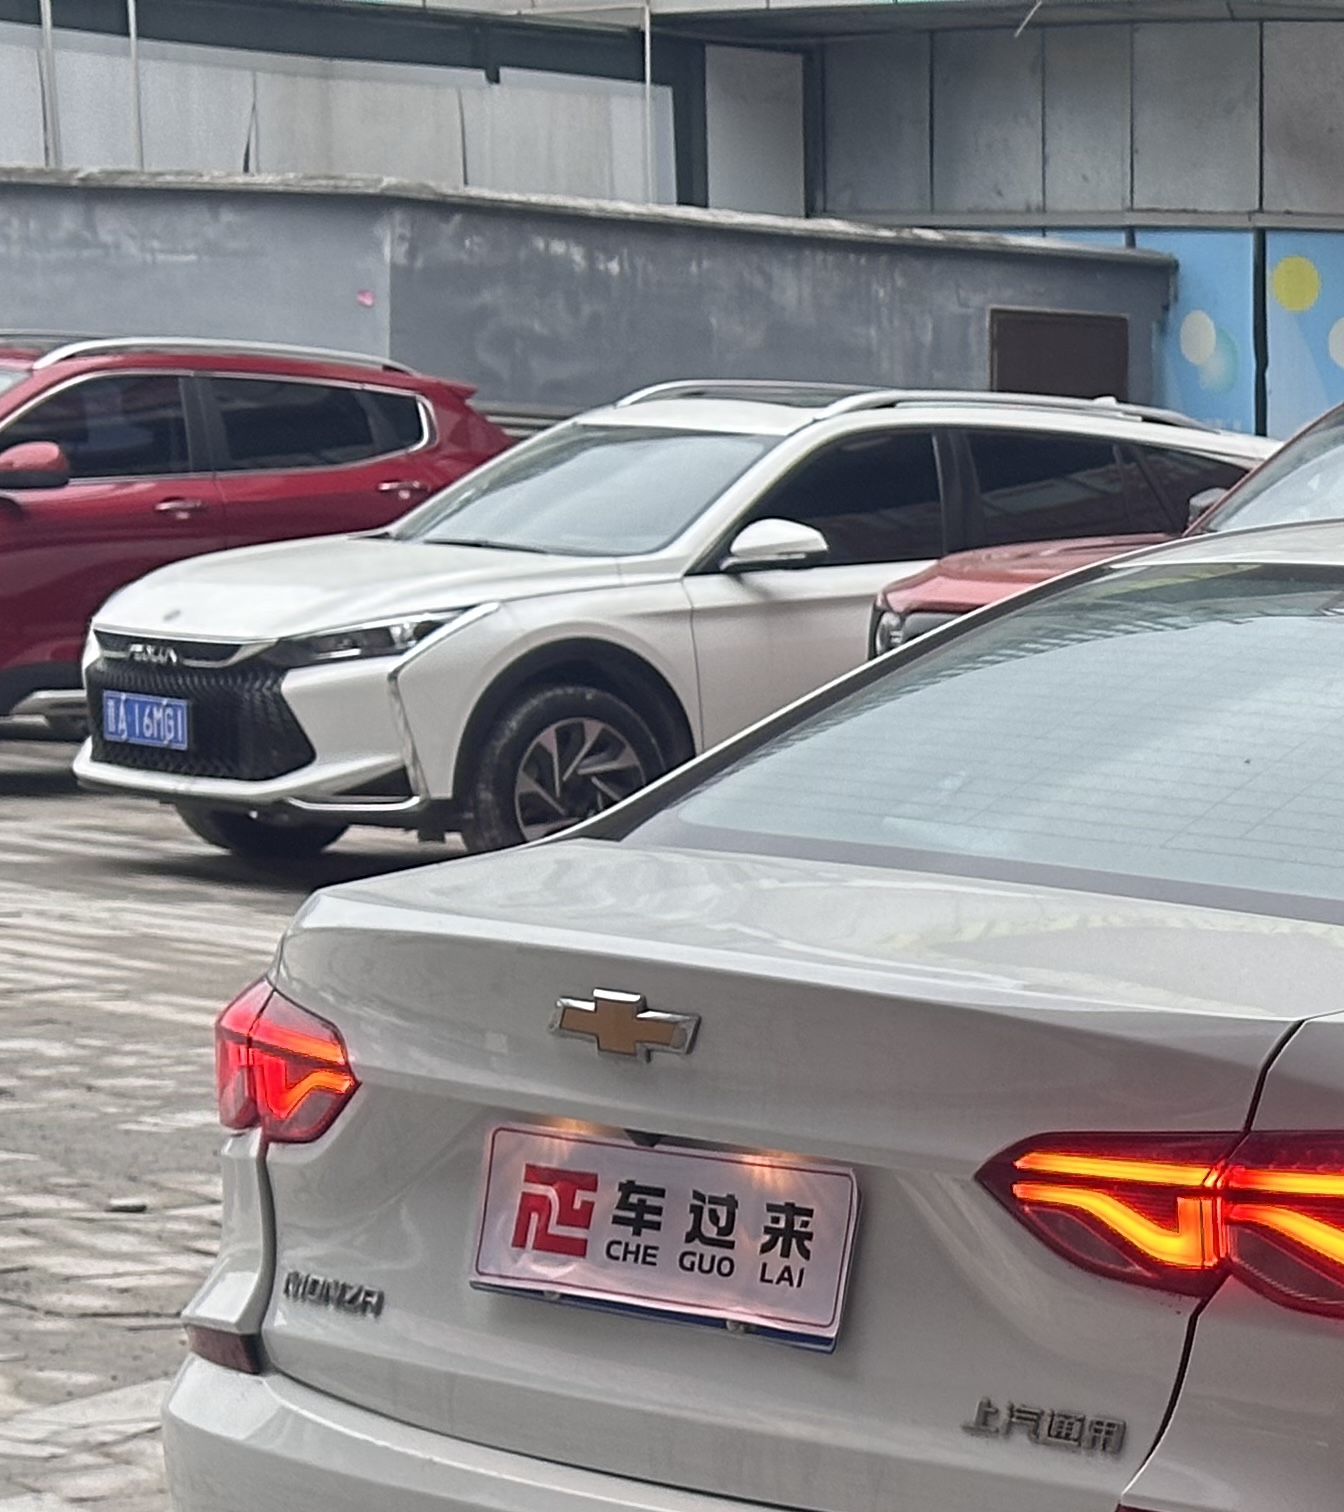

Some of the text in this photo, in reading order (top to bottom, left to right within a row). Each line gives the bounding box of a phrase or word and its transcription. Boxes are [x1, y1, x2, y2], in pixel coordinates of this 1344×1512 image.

[610, 1178, 815, 1262] 车过来
[604, 1238, 806, 1290] CHE GUO LAI
[284, 1270, 385, 1318] MONZA
[960, 1396, 1127, 1456] 上汽通用
